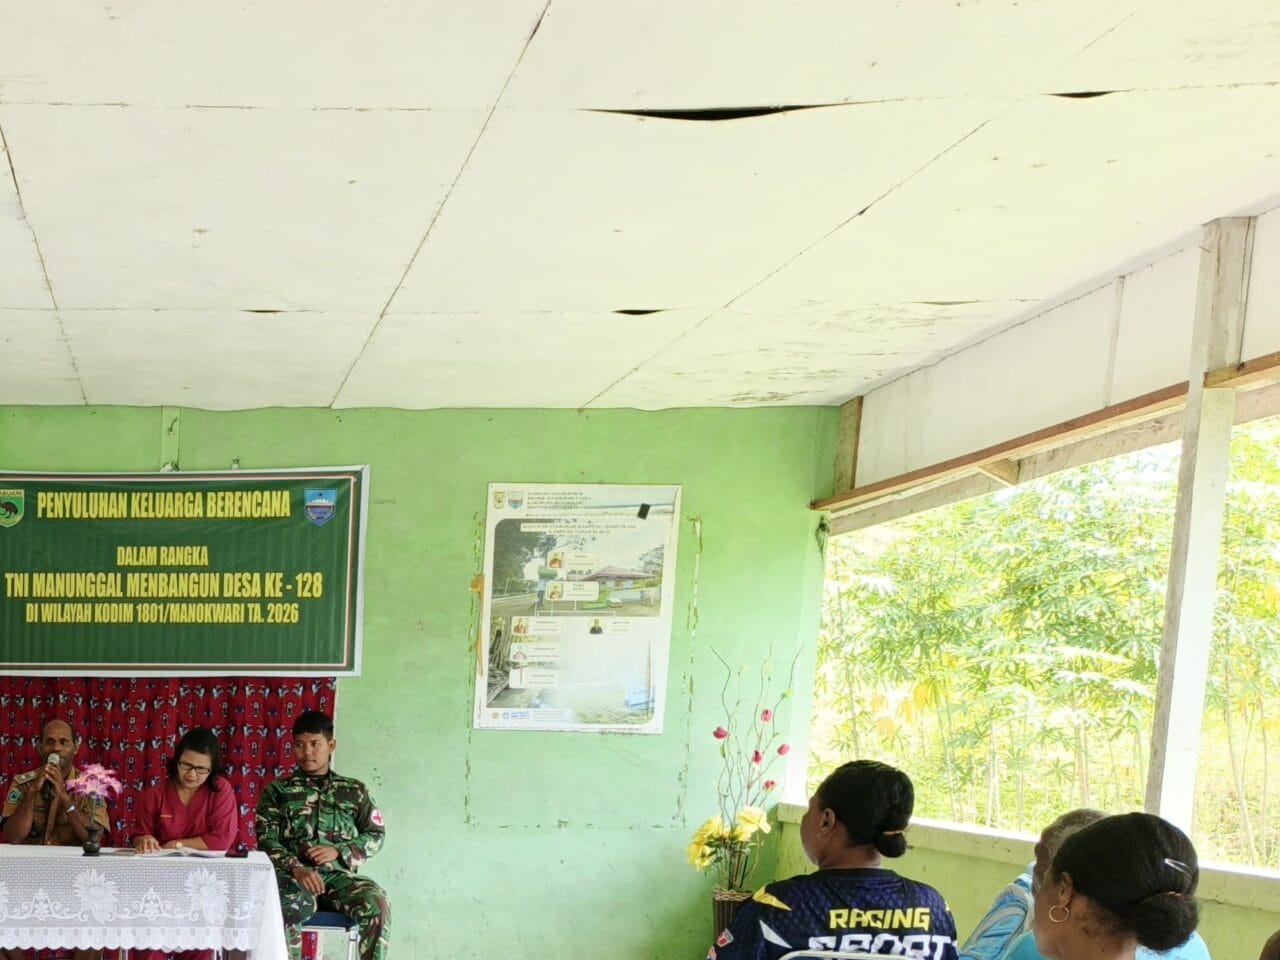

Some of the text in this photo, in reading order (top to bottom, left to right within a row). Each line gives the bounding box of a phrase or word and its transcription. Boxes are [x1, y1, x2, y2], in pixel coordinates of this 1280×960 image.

[37, 490, 291, 518] PENYULUHAN KELUARGA BERENCANA
[117, 546, 209, 566] DALAM RANGKA
[5, 572, 29, 598] TNI
[32, 572, 123, 598] MANUNGGAL
[126, 572, 220, 598] MENBANGUN
[223, 572, 261, 598] DESA
[265, 572, 283, 598] KE
[295, 572, 323, 598] 128
[26, 603, 299, 624] DI WILAYAH KODIM 1801/MANOKWARI TA. 2026
[829, 907, 931, 931] RACING
